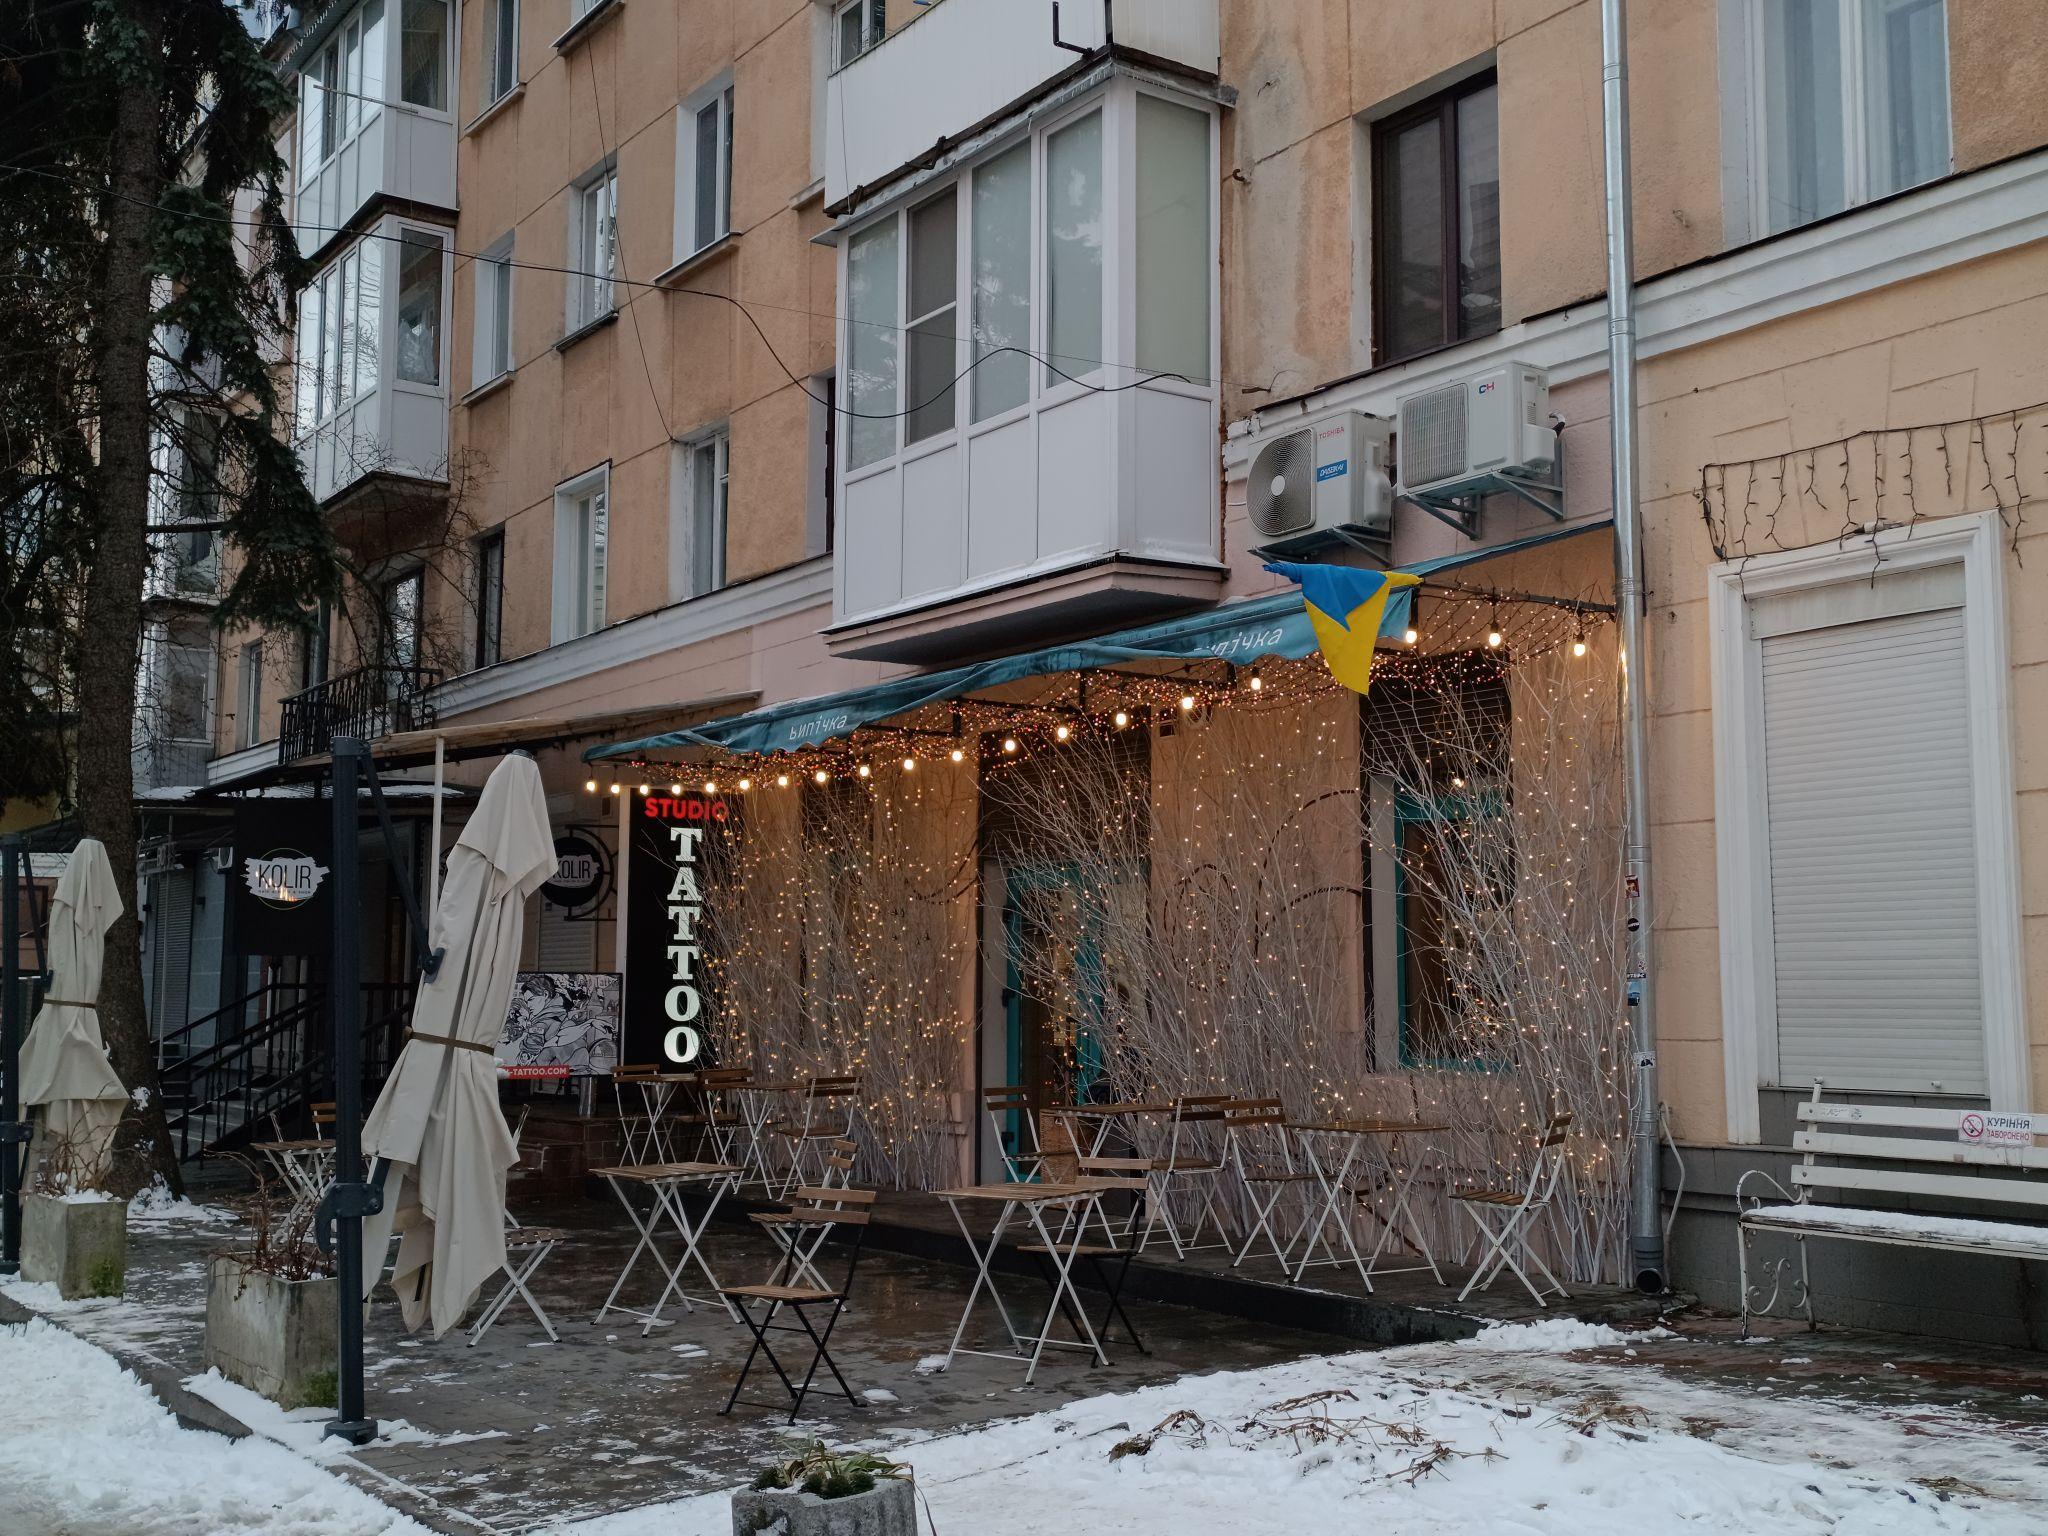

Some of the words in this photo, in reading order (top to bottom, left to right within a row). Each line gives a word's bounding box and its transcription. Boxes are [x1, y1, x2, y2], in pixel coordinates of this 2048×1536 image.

[1479, 381, 1495, 394] CH
[1319, 426, 1345, 439] TOSHIBA
[645, 797, 728, 822] STUDIO
[258, 864, 311, 889] KOLIR
[664, 827, 703, 1063] TATTOO
[506, 1067, 567, 1076] -TATTOO.COM
[1987, 1117, 2030, 1129] КУРІННЯ
[1987, 1128, 2030, 1141] ЗАБОРОНЕНО
